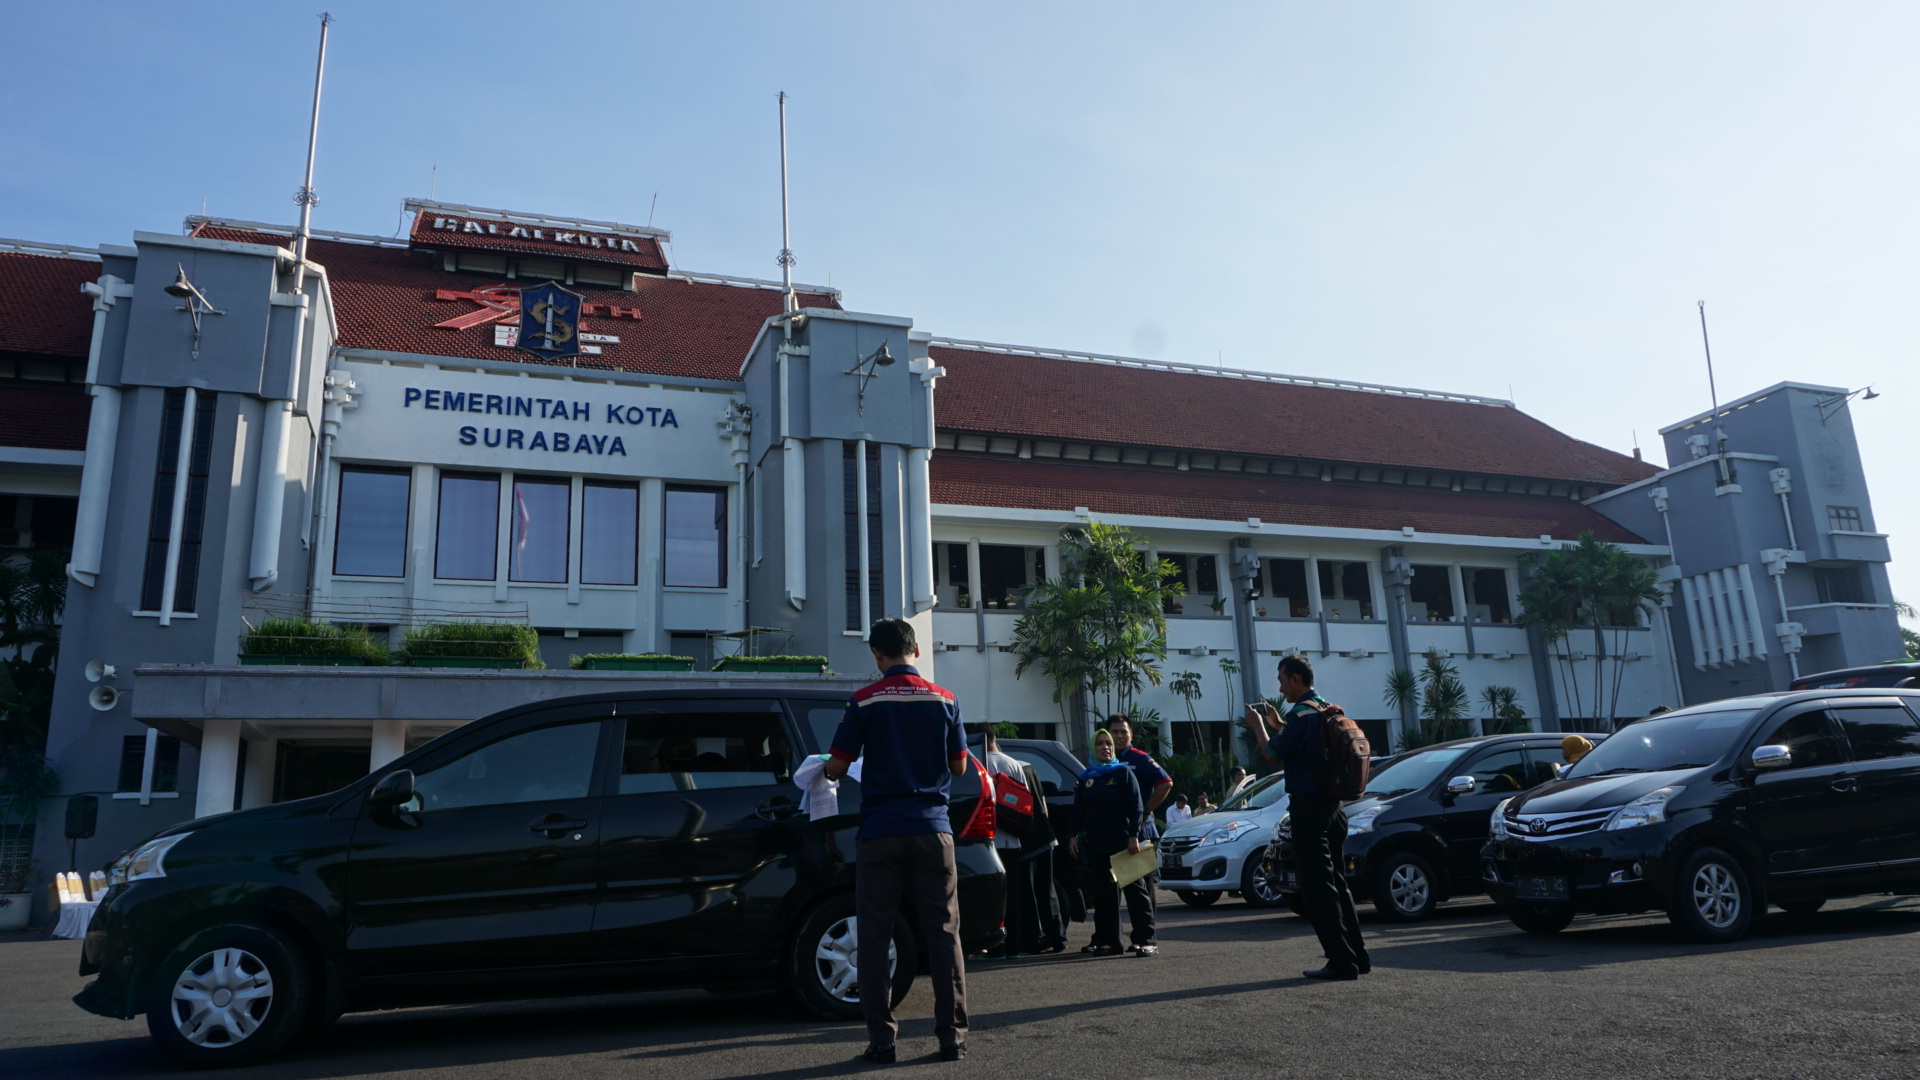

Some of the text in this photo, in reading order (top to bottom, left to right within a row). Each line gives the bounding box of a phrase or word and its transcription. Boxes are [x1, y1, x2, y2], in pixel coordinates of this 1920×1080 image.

[404, 387, 679, 428] PEMERINTAH KOTA
[459, 425, 627, 456] SURABAYA
